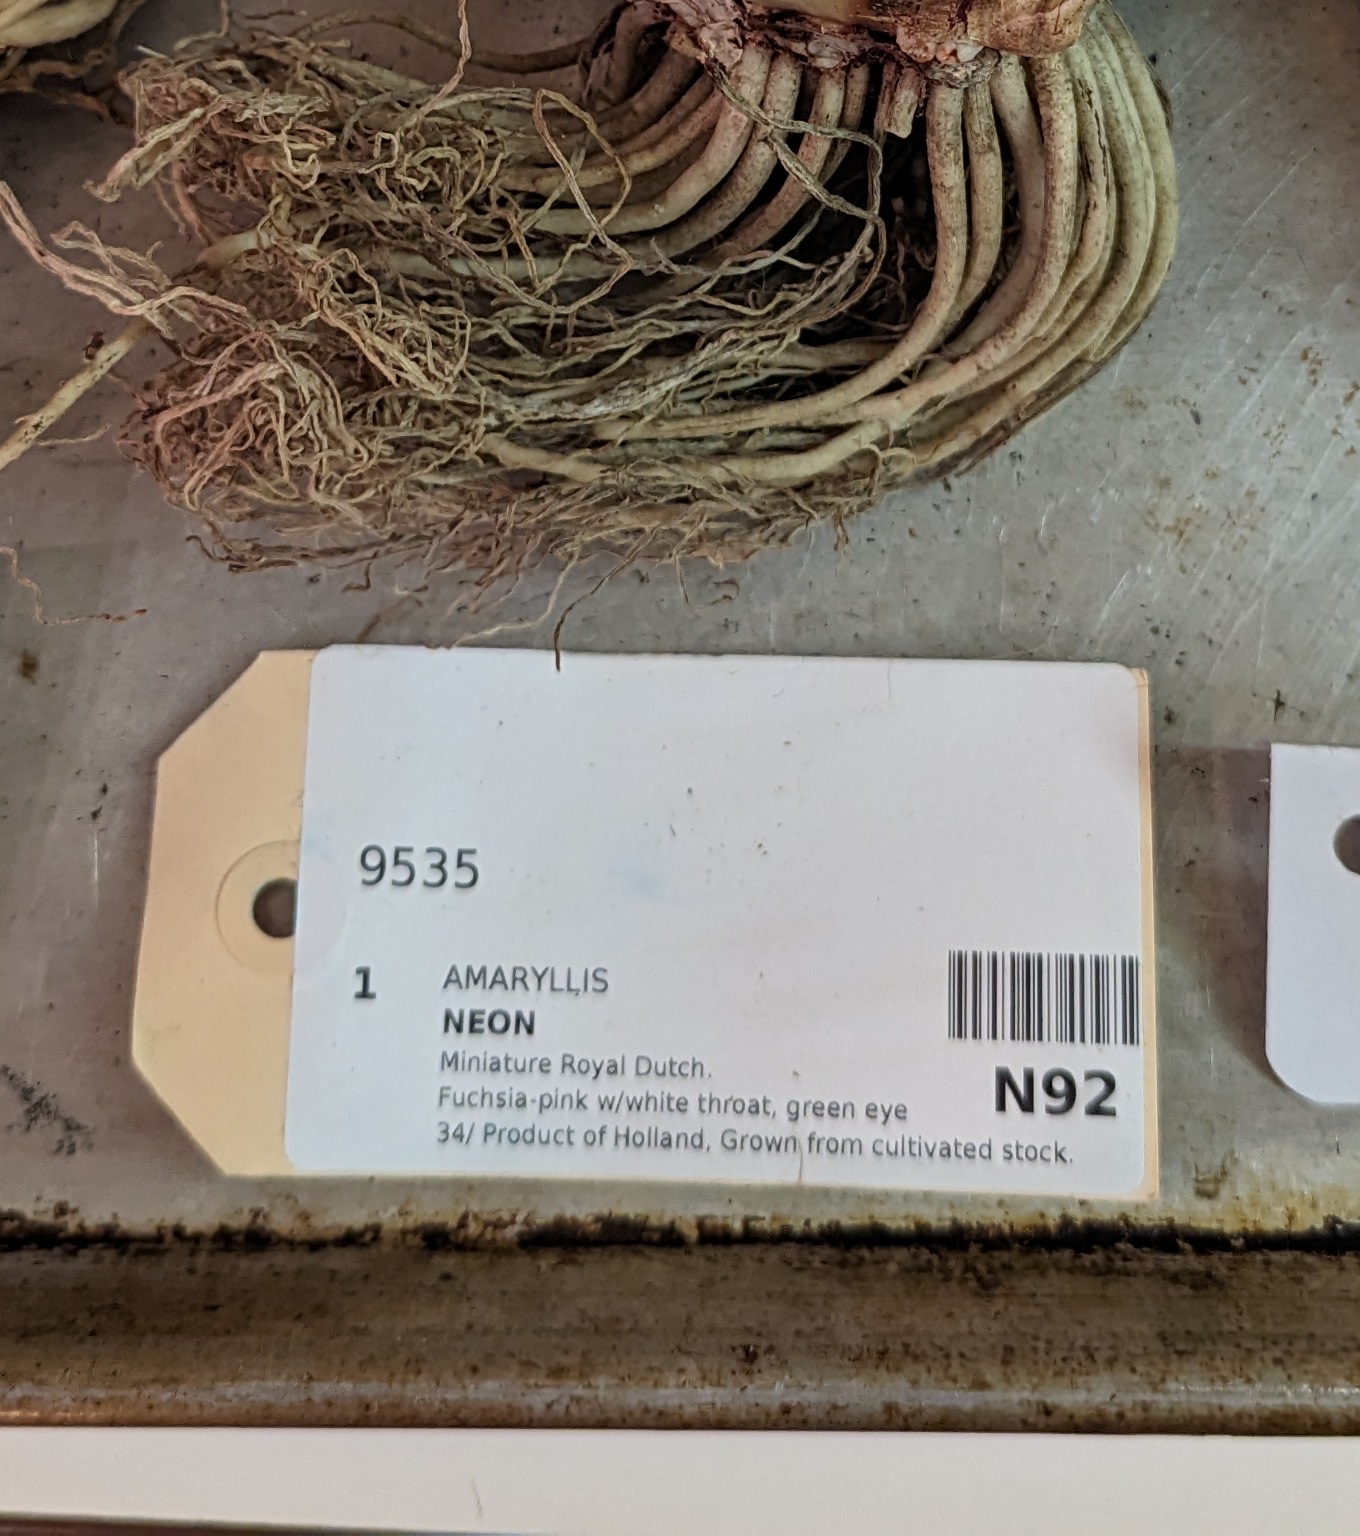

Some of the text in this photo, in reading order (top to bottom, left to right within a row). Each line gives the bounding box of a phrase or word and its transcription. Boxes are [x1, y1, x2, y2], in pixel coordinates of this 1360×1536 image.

[360, 845, 479, 889] 9535
[355, 967, 376, 1000] 1
[442, 965, 608, 996] AMARYLLIS
[444, 1009, 535, 1036] NEON
[440, 1050, 711, 1083] Miniature Royal Dutch.
[438, 1086, 907, 1127] Fuchsia-pink w/white throat, green eye
[995, 1067, 1116, 1117] N92
[437, 1122, 1074, 1164] 34/ Product of Holland, Grown from cultivated stock.
